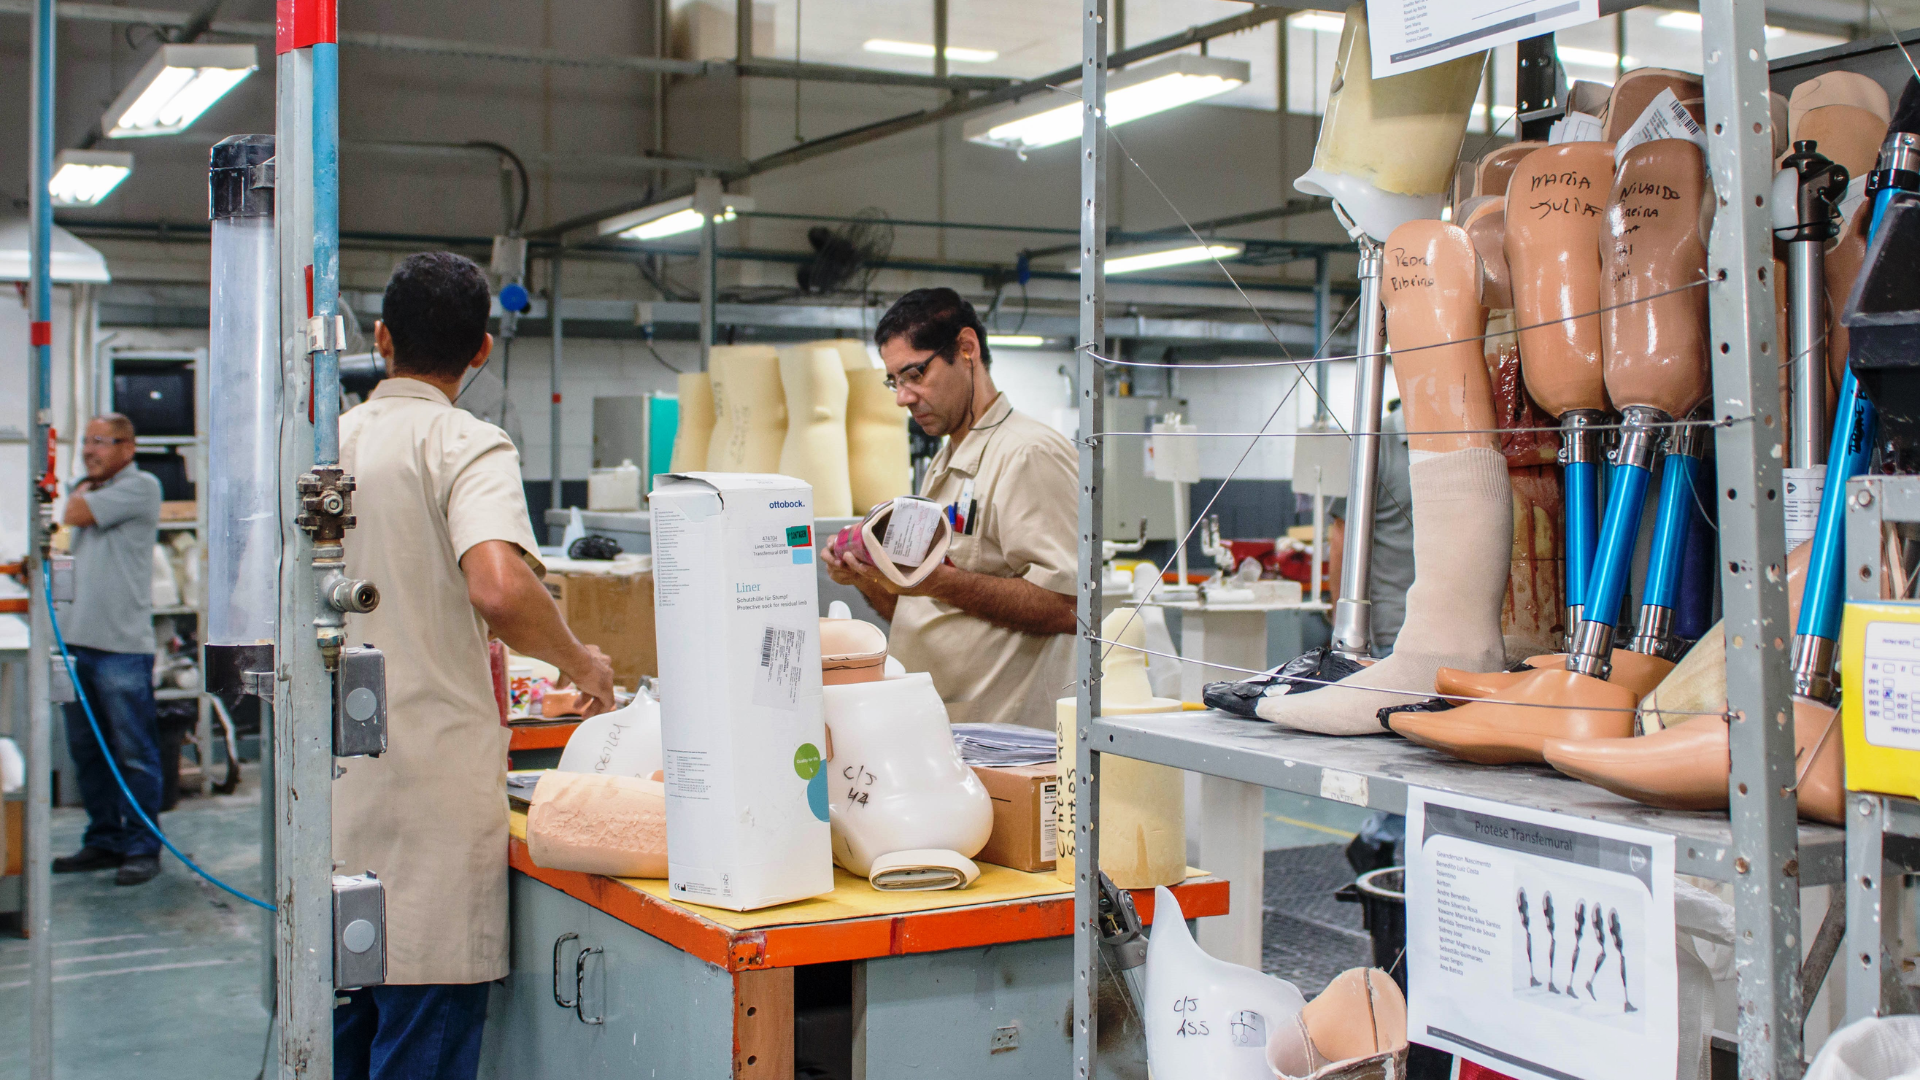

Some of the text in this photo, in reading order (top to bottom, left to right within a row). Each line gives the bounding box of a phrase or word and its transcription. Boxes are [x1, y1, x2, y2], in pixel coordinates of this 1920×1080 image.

[1531, 171, 1591, 192] MARIA
[736, 582, 761, 593] Liner
[1475, 821, 1572, 852] Protese Transfemural
